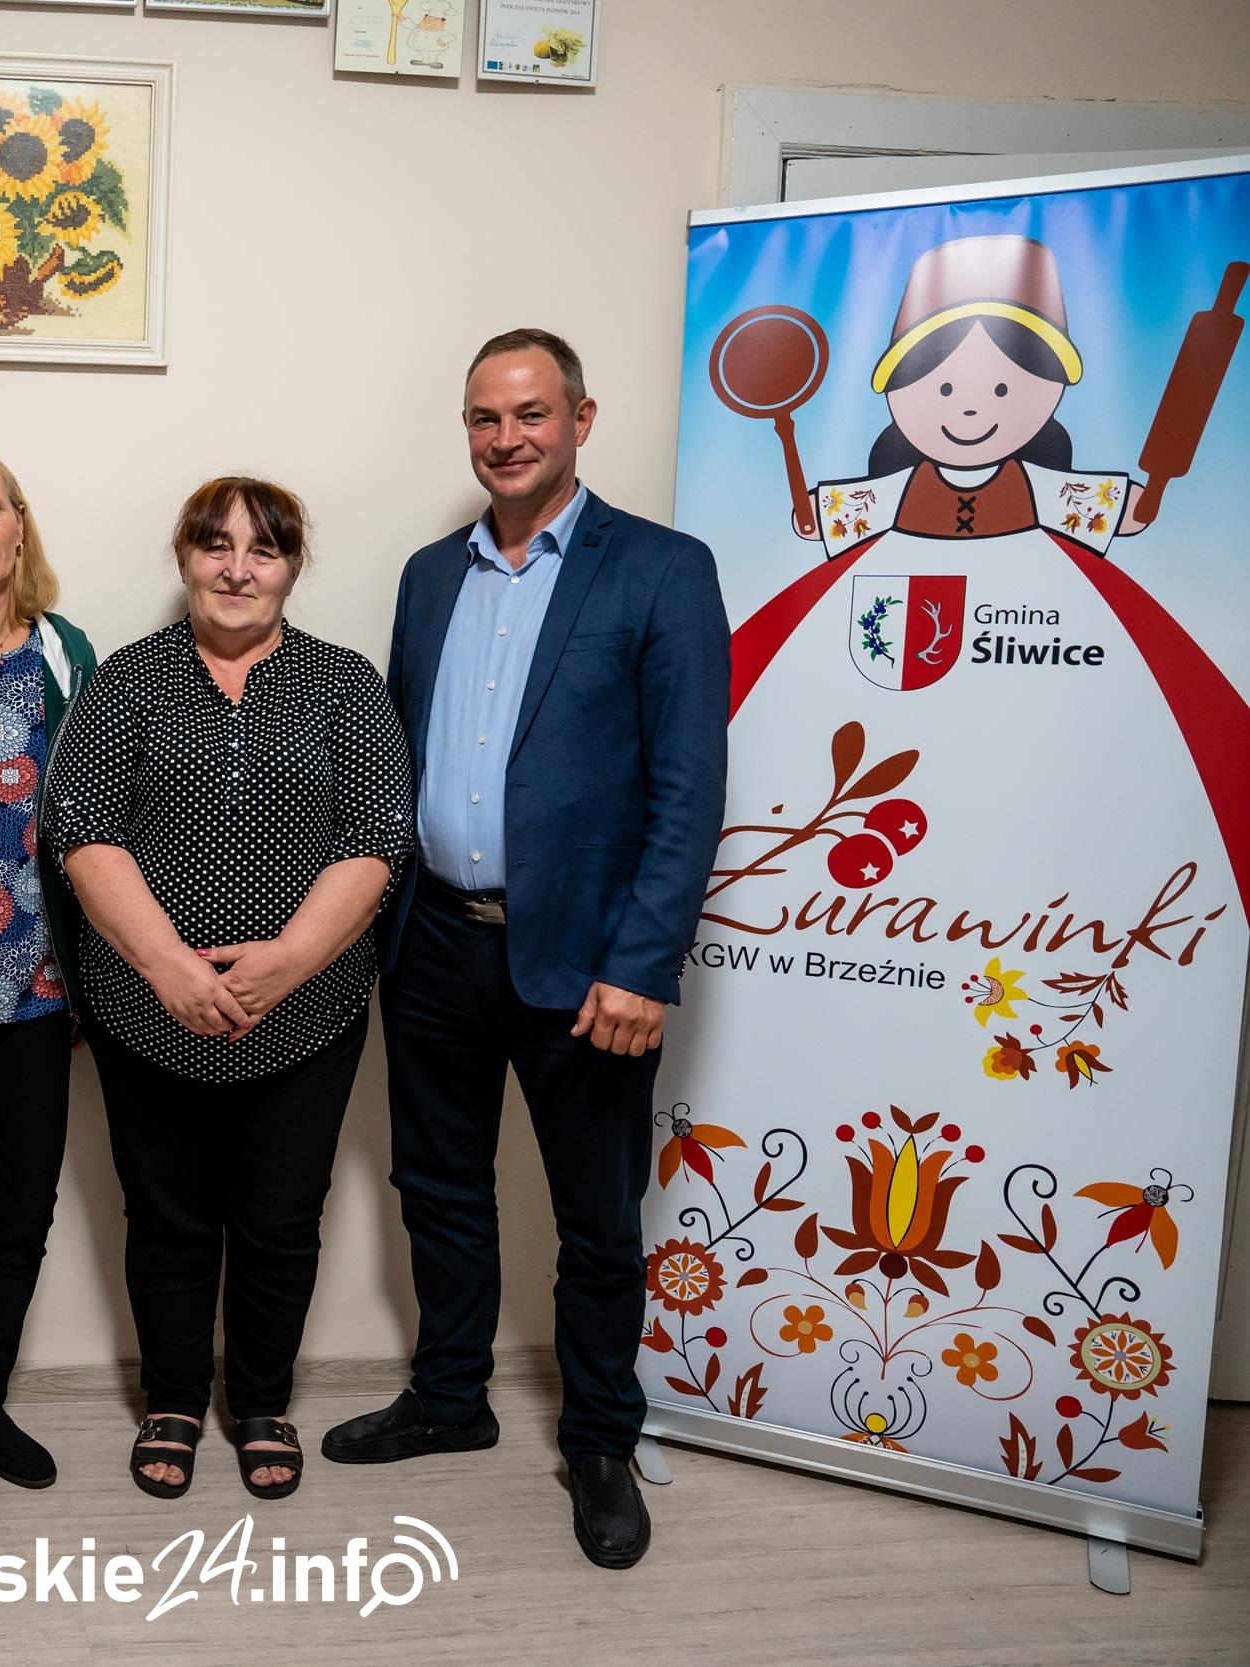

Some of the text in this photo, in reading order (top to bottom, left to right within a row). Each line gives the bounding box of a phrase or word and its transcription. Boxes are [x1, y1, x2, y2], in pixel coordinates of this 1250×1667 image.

[973, 603, 1061, 626] Gmina
[971, 635, 1106, 666] Śliwice
[701, 803, 1227, 969] Żurawinki
[769, 954, 795, 975] w
[805, 951, 946, 989] Brzeźnie
